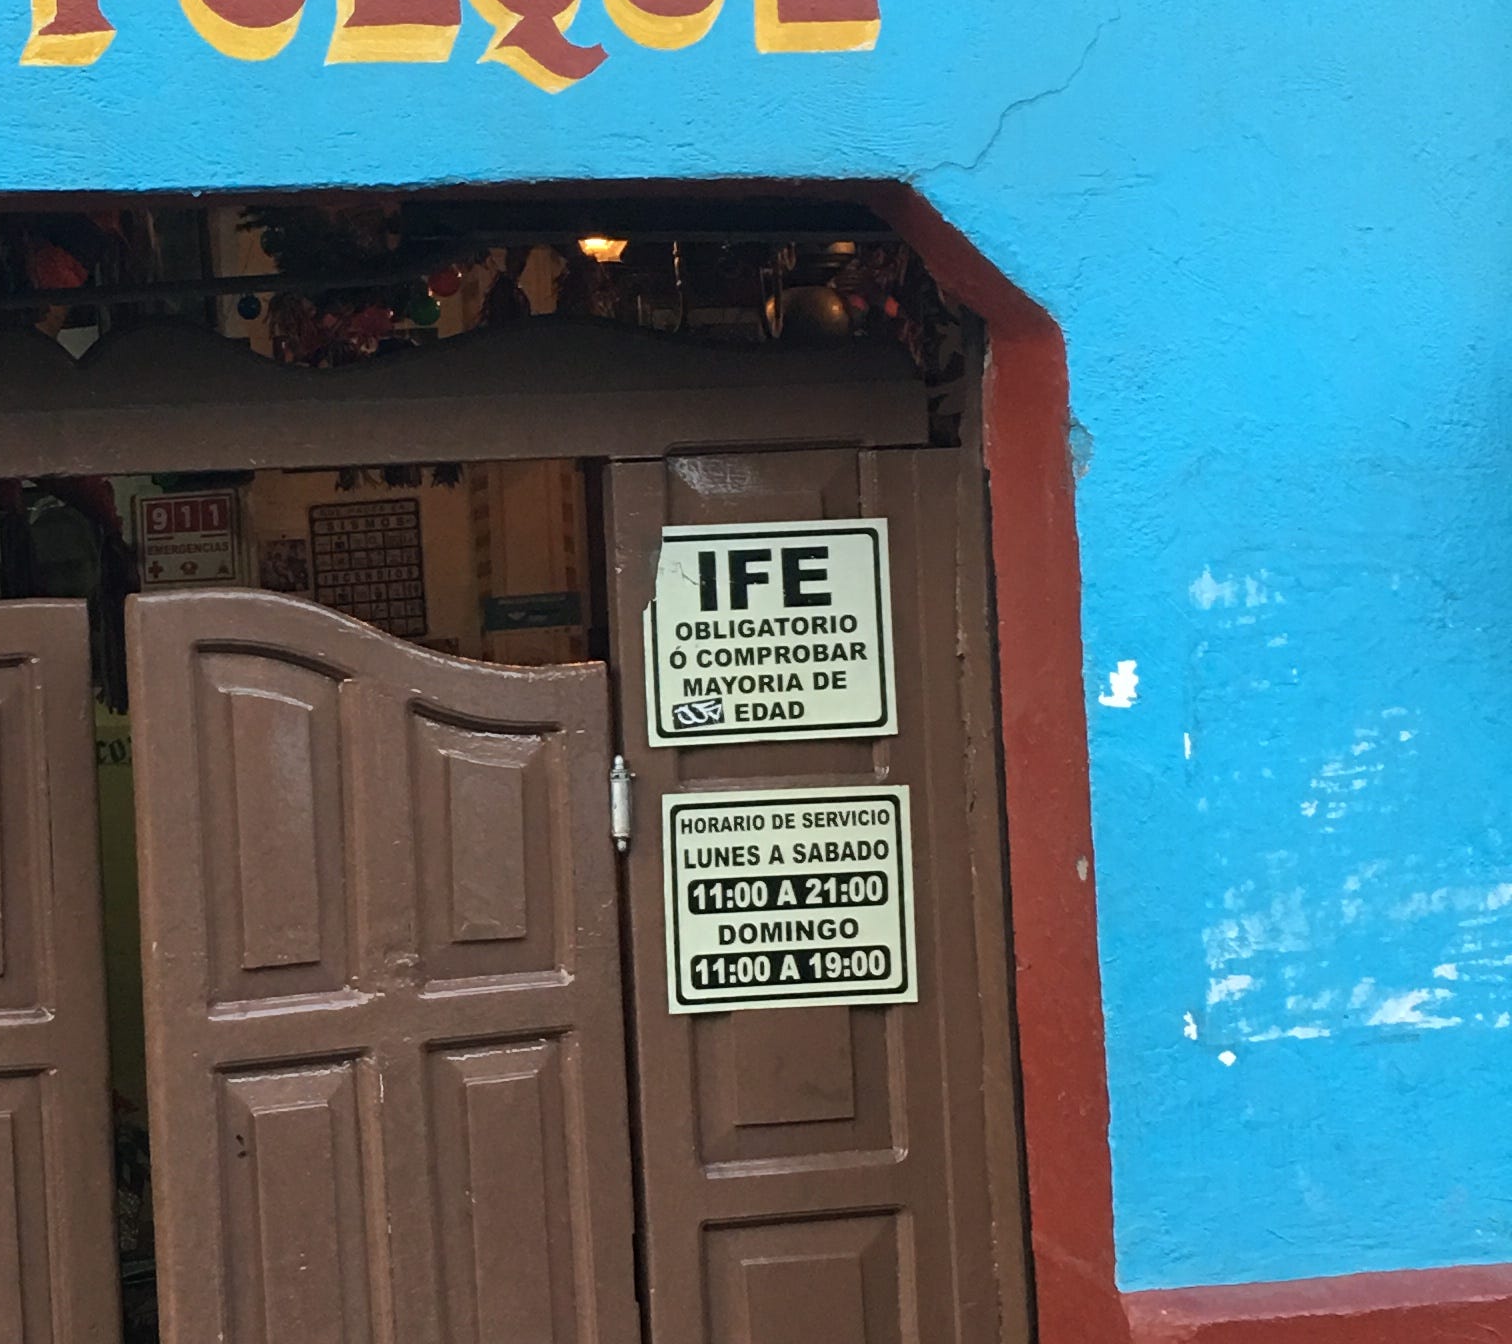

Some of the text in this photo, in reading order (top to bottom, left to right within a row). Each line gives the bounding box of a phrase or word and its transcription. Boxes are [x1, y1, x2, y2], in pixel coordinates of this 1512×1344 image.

[152, 503, 219, 530] 911
[148, 541, 229, 555] EMERGENCIAS
[698, 546, 832, 612] IFE
[675, 614, 858, 641] OBLIGATORIO
[669, 642, 868, 669] Ó COMPROBAR
[683, 671, 847, 697] MAYORIA DE
[735, 701, 805, 722] EDAD
[681, 809, 891, 835] HORARIO DE SERVICIO
[684, 839, 889, 869] LUNES A SABADO
[693, 875, 884, 910] 11:00 A 21:00
[718, 918, 859, 946] DOMINGO
[695, 949, 886, 985] 11:00 A 19:00
